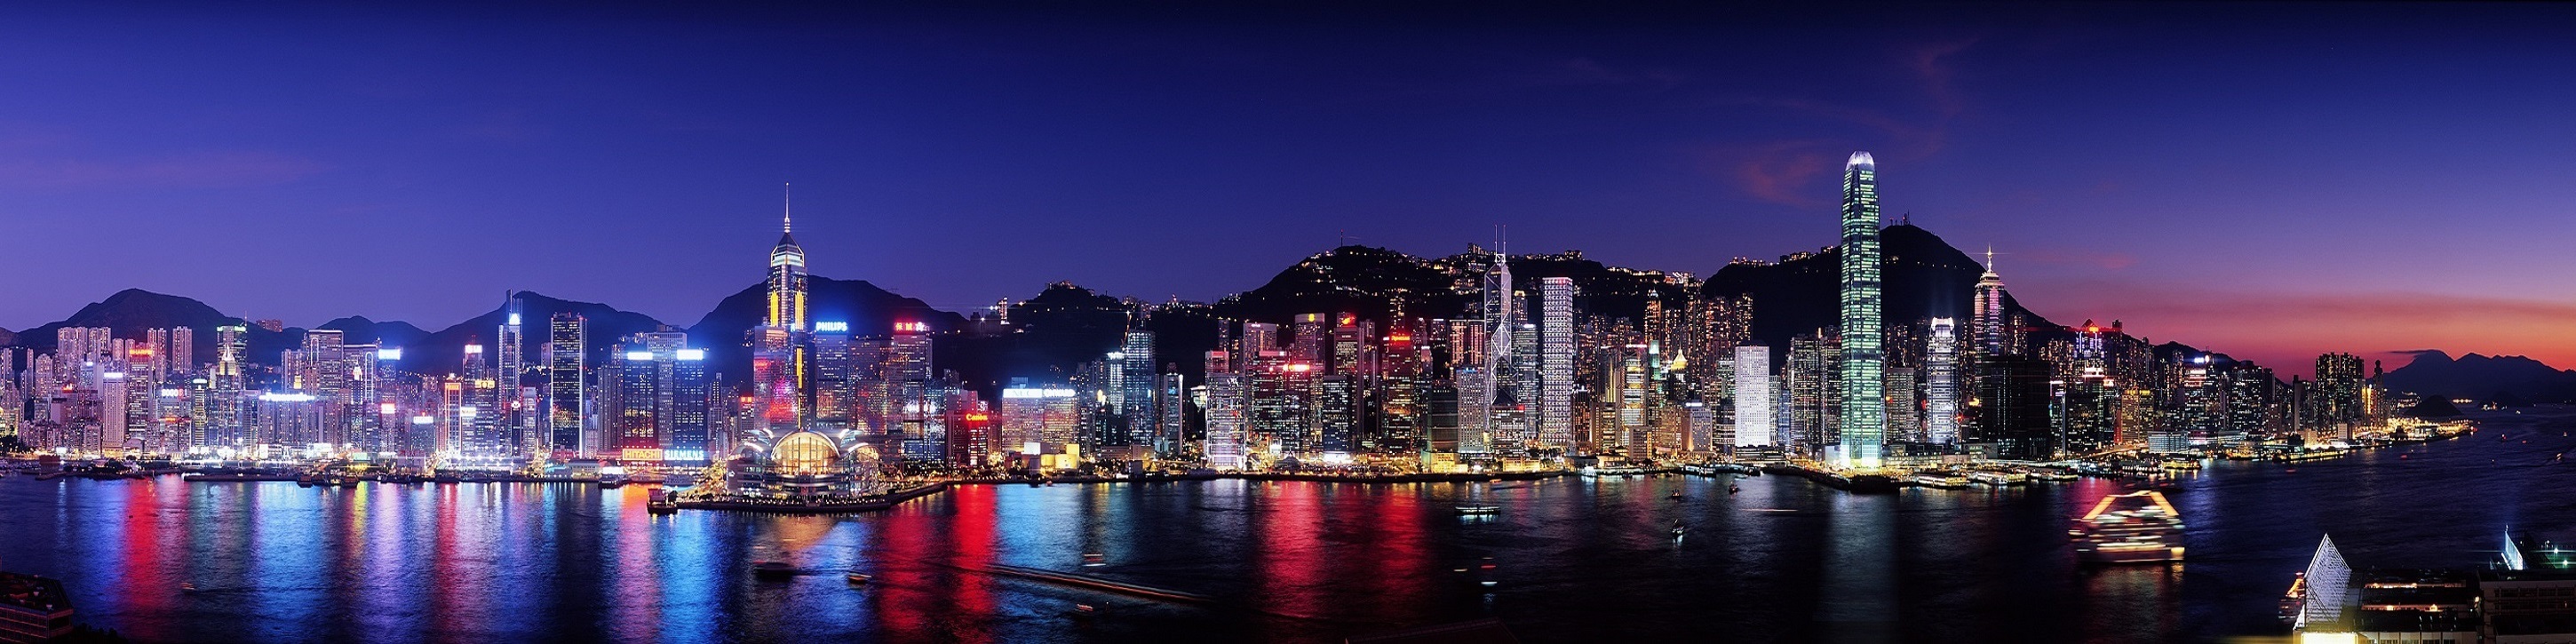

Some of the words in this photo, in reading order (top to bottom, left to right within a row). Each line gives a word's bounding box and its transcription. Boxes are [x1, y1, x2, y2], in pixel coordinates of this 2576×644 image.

[815, 322, 847, 331] PHILIPS
[624, 450, 660, 459] HITACHI
[664, 449, 704, 460] SIEMENS
